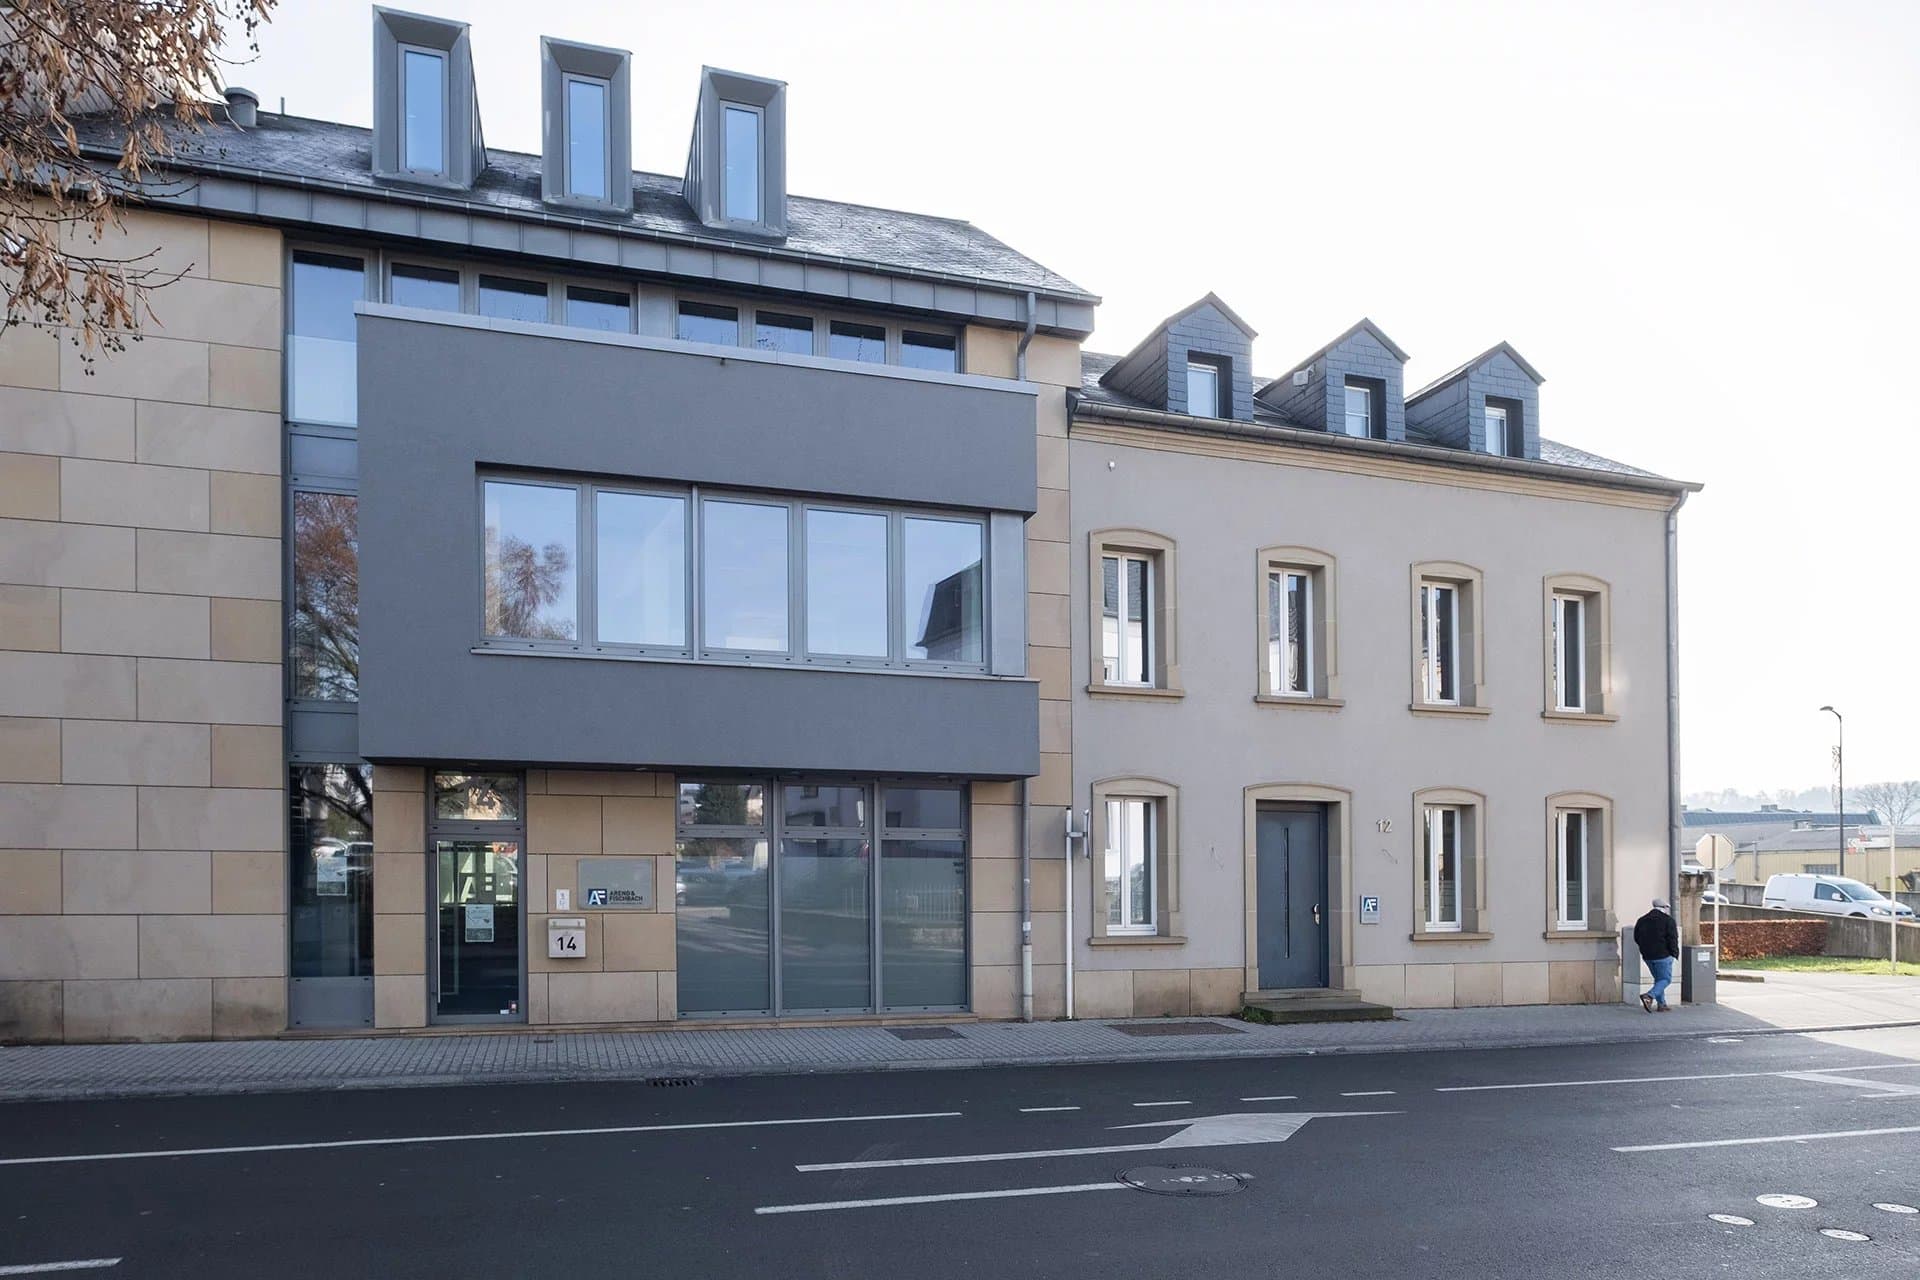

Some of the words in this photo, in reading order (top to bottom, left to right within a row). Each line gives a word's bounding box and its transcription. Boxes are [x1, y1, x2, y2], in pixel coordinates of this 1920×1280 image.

[1376, 819, 1392, 833] 12
[588, 890, 606, 905] AF
[1363, 899, 1376, 912] AF
[557, 936, 576, 951] 14
